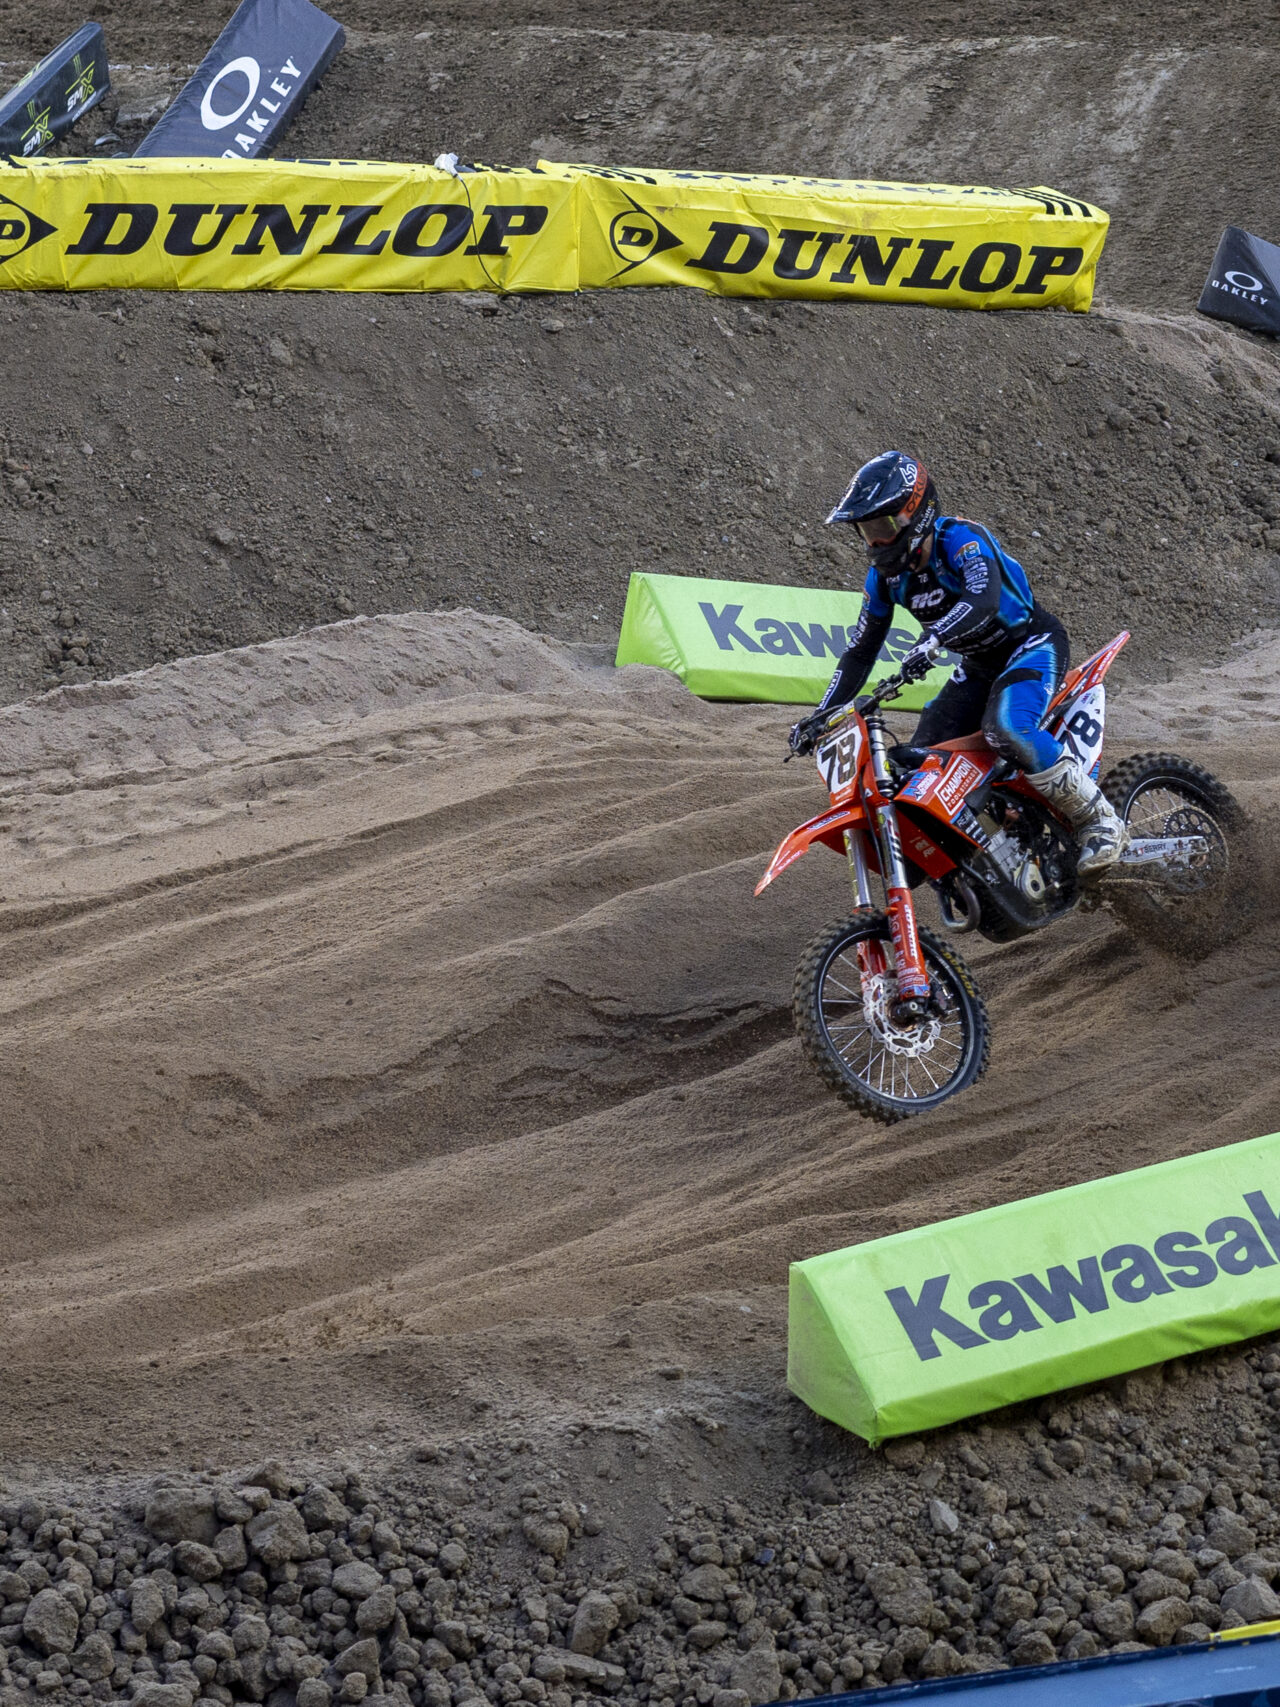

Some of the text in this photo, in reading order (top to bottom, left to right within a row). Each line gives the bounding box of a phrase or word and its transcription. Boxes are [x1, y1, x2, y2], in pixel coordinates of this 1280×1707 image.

[65, 203, 548, 257] DUNLOP
[685, 221, 1084, 295] DUNLOP
[1211, 279, 1269, 306] OAKLEY
[821, 732, 856, 794] 78
[1057, 710, 1104, 766] 78
[940, 759, 973, 802] CHAMPION
